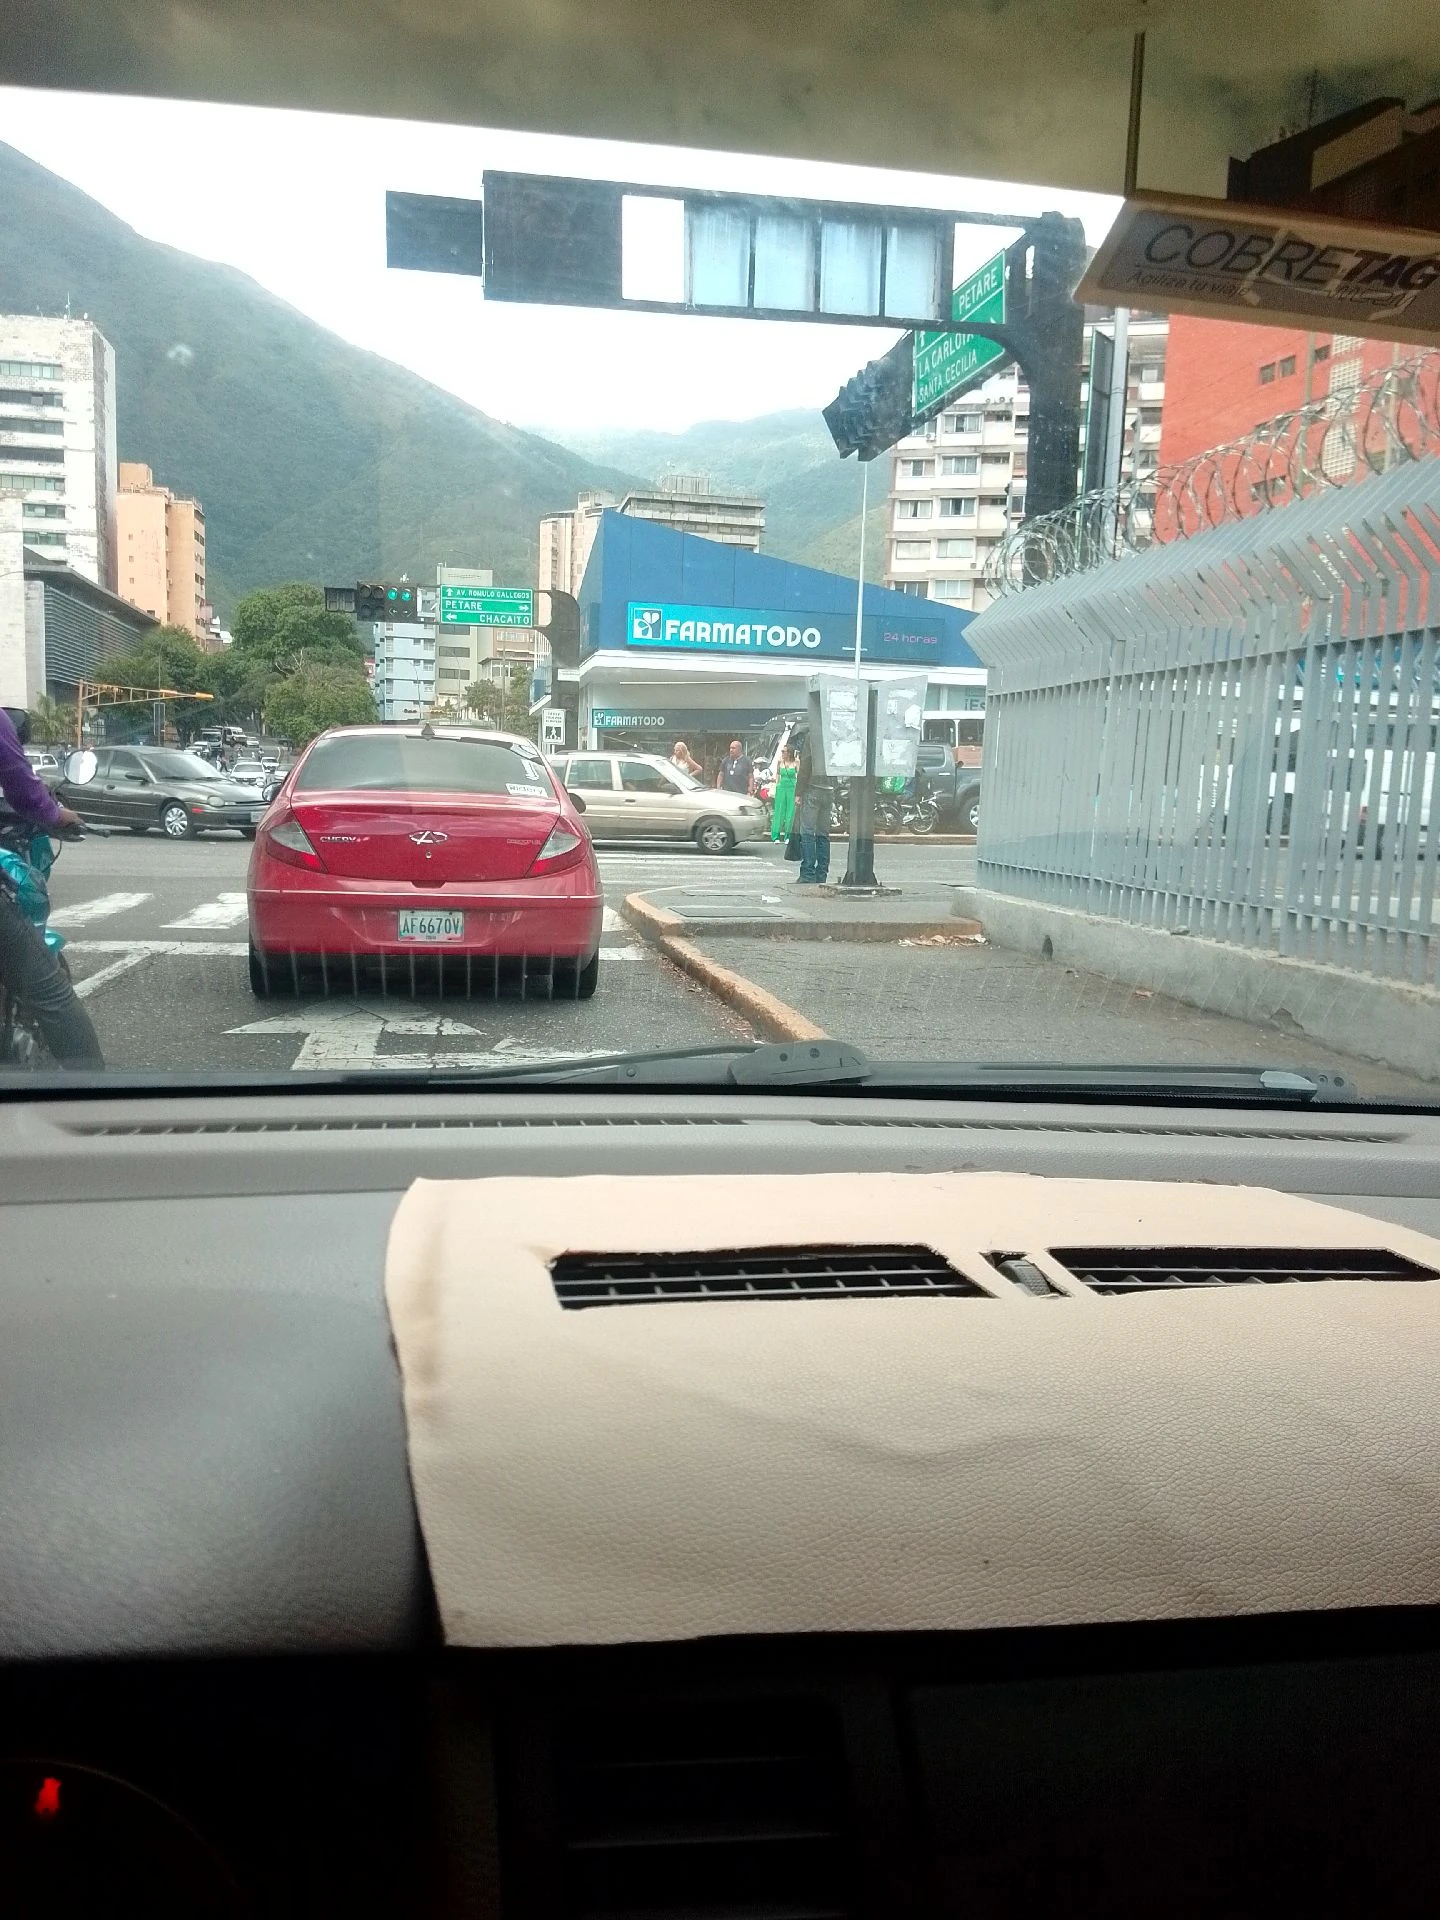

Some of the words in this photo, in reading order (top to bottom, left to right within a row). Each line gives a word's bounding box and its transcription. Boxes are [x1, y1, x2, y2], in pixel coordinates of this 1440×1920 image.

[958, 266, 998, 315] PETARE
[919, 356, 930, 379] LA
[919, 373, 943, 402] SANTA
[945, 348, 977, 383] CECILIA
[468, 590, 495, 598] ROMULO
[496, 590, 530, 599] GALLEGOS
[445, 600, 483, 610] PETARE
[479, 614, 530, 625] CHACAITO
[665, 619, 821, 649] FARMATODO
[883, 632, 899, 643] 24
[902, 633, 938, 644] horas
[605, 715, 665, 726] FARMATODO
